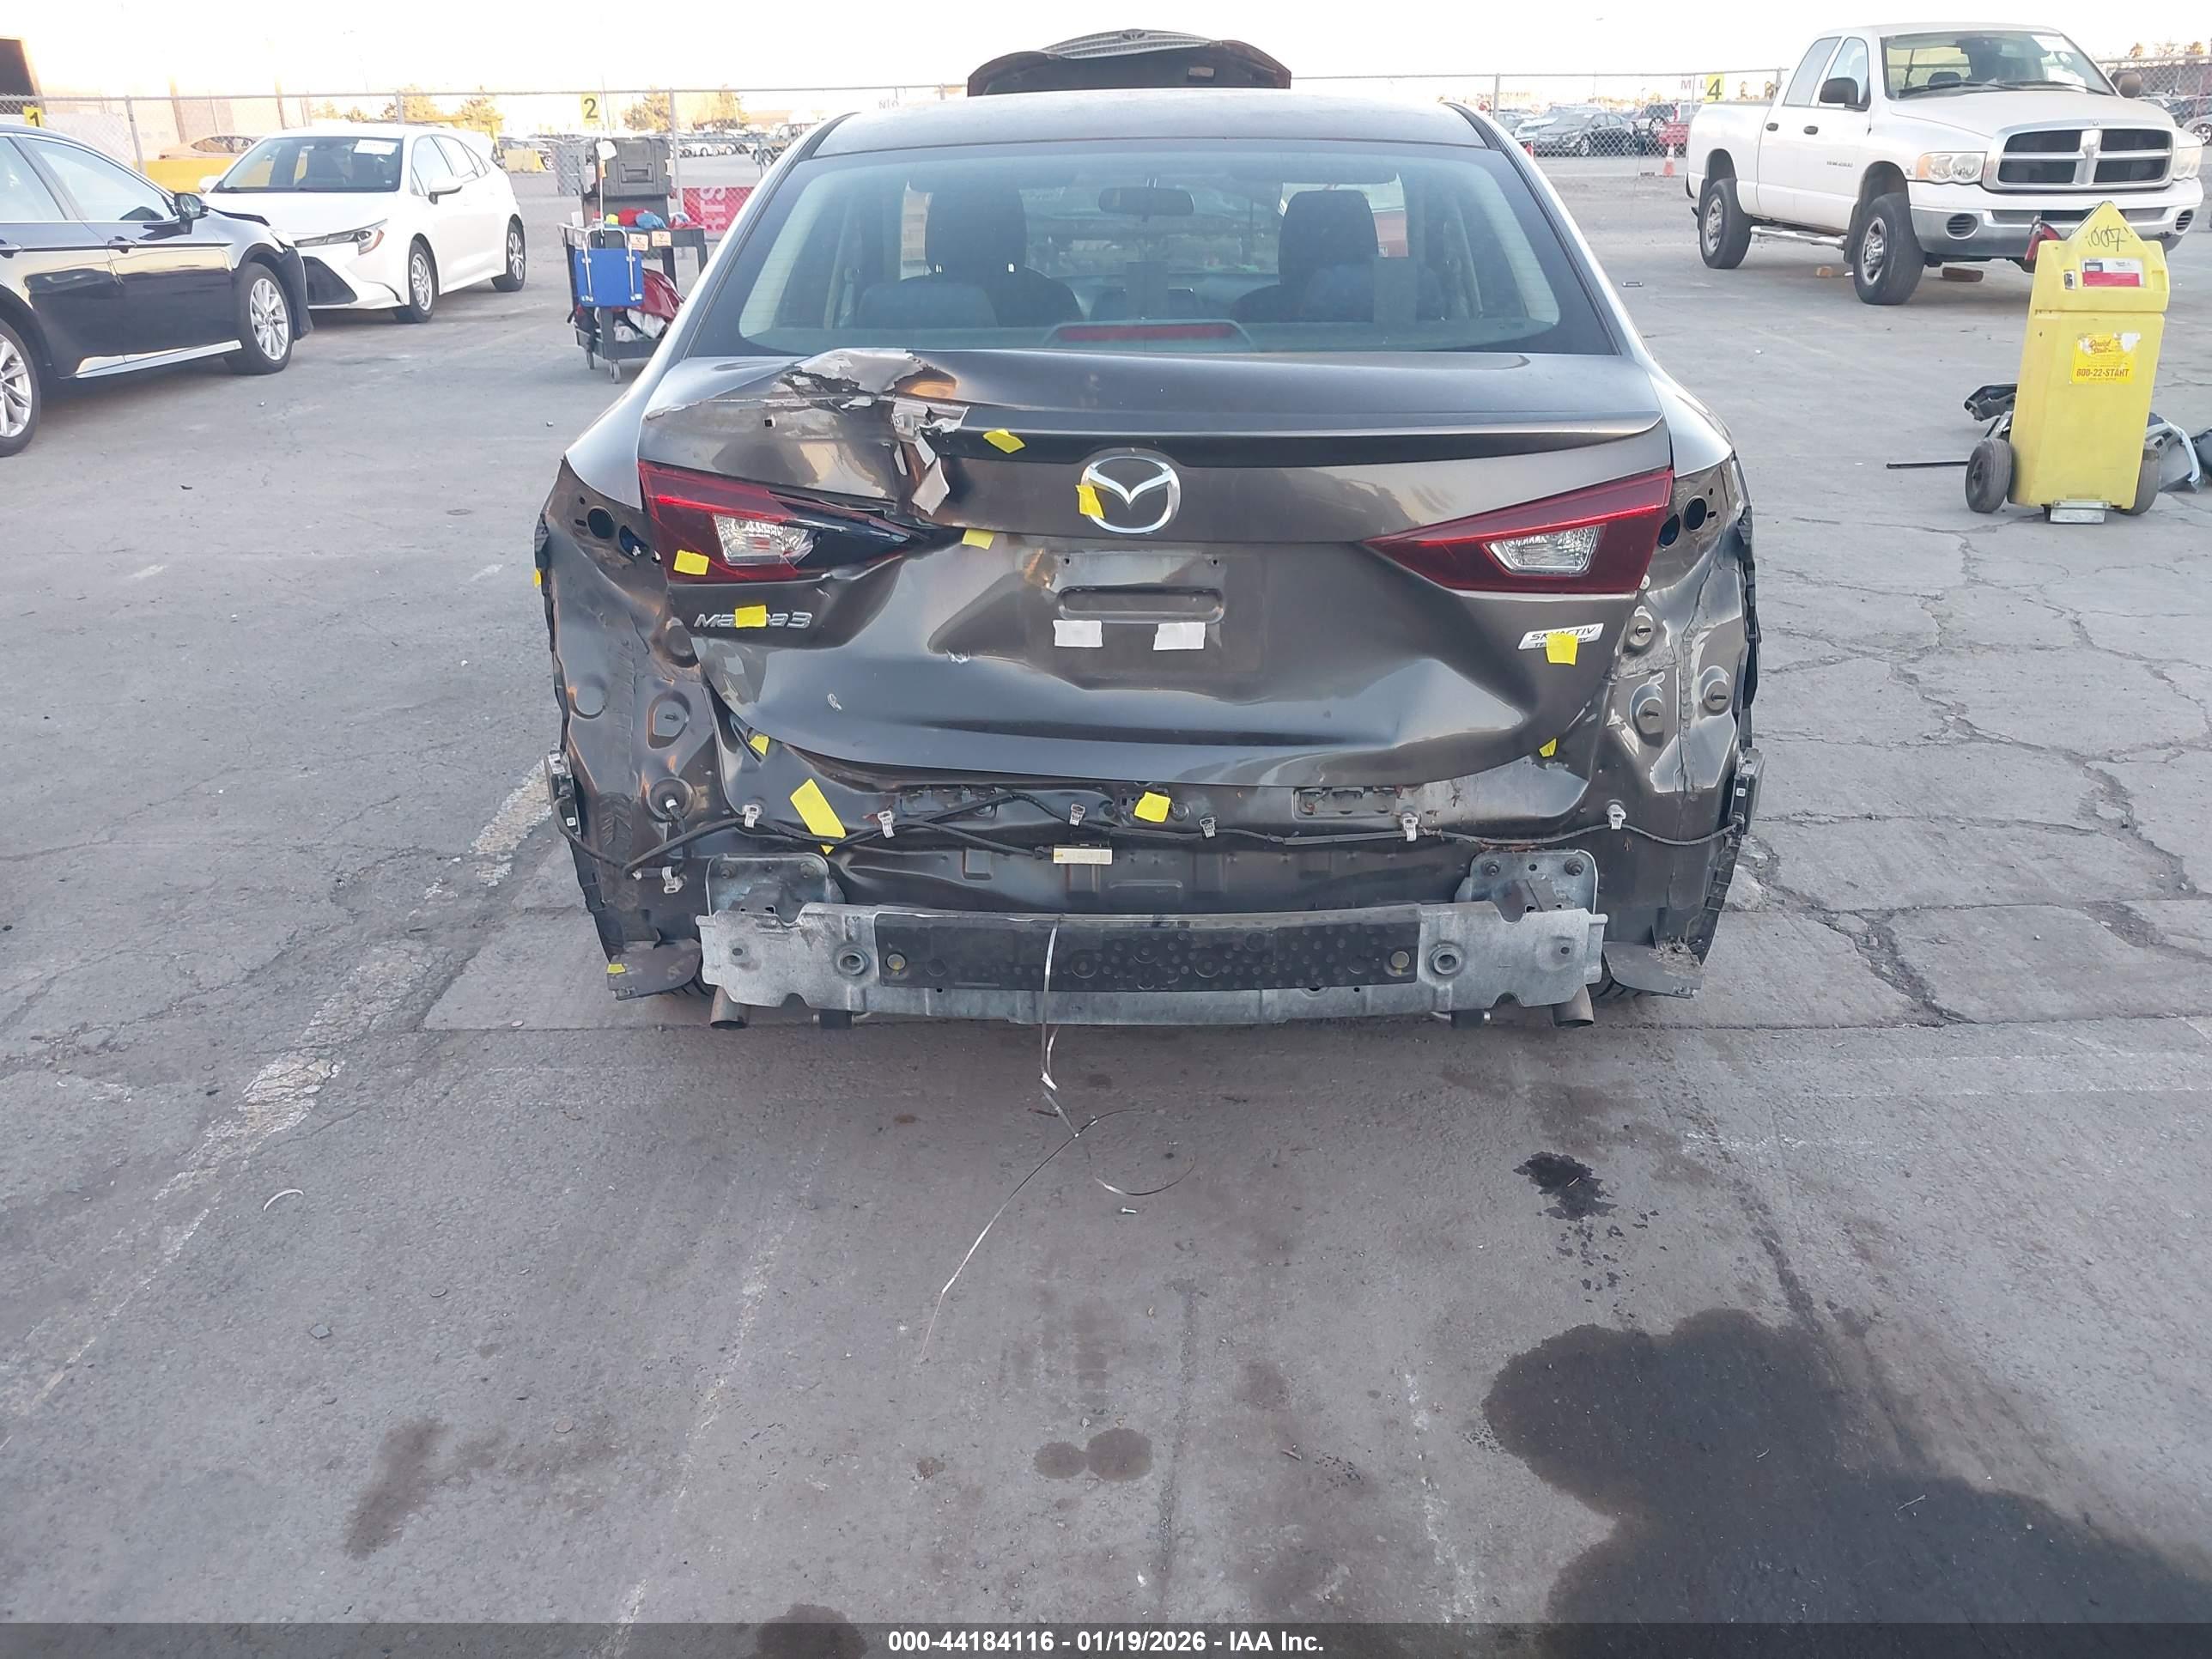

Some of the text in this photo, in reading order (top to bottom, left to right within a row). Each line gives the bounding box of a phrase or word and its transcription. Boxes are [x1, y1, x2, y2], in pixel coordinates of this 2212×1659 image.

[1706, 78, 1723, 100] 4
[584, 98, 599, 118] 2
[29, 112, 40, 127] 1
[694, 611, 813, 629] Maa3
